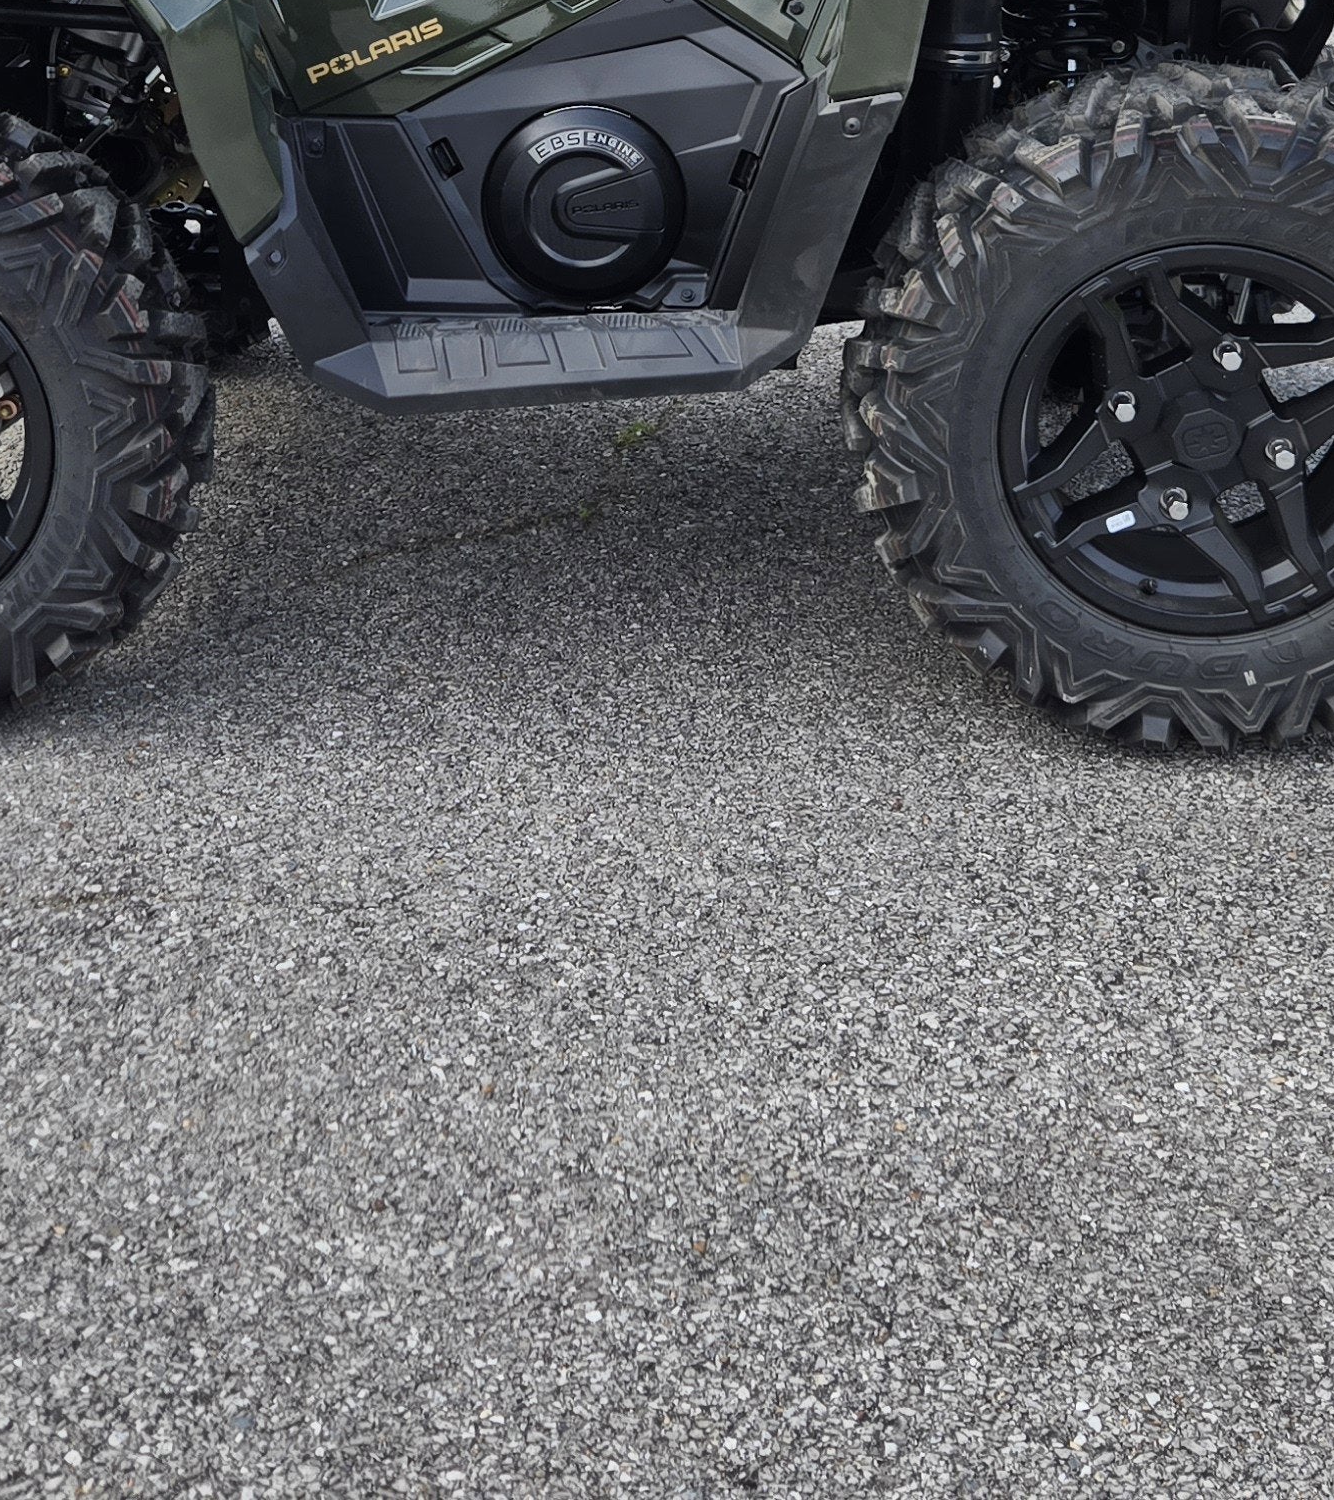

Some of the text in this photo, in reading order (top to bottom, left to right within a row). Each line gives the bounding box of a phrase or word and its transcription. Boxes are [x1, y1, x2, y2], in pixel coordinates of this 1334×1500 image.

[306, 17, 443, 84] POLARIS
[535, 131, 641, 164] EBS ENGINE
[571, 199, 640, 216] POLARIS
[1034, 600, 1239, 681] DURO
